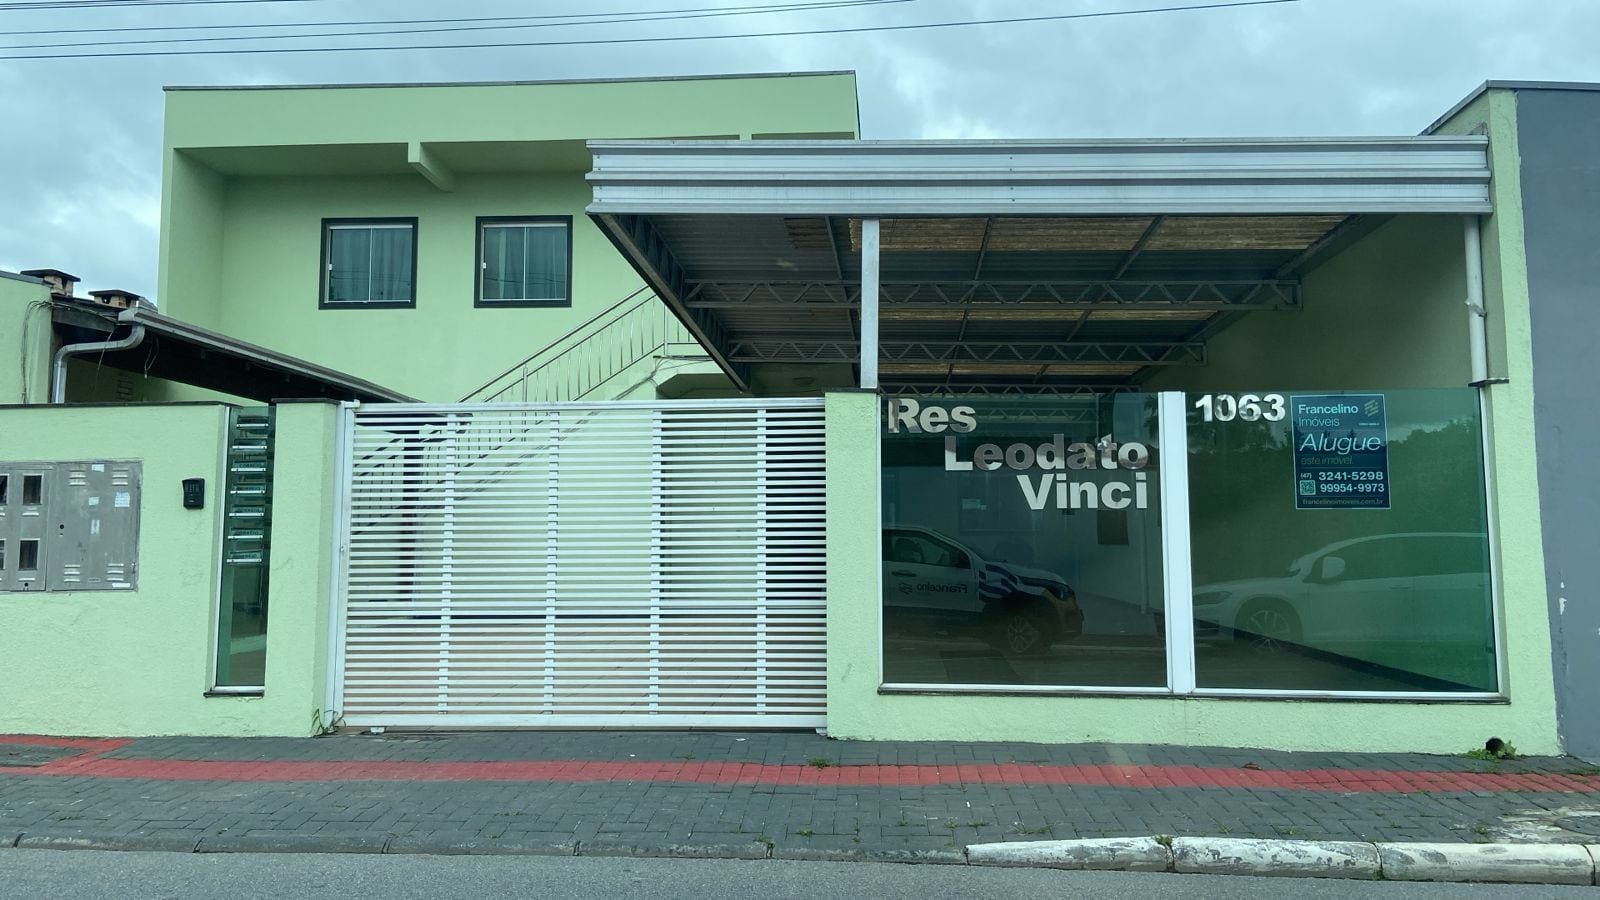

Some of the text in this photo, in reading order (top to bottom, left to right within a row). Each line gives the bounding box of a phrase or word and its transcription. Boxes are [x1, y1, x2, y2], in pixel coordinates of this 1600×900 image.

[887, 398, 977, 434] Res
[1195, 393, 1286, 422] 1063
[1298, 403, 1359, 414] Francelino
[1298, 417, 1340, 427] Imóveis
[944, 433, 1149, 471] Leodato
[1299, 432, 1381, 455] Alugue
[1301, 456, 1320, 465] este
[1318, 471, 1384, 481] 3241-5298
[1016, 471, 1147, 510] Vinci
[1320, 483, 1385, 493] 99954-9973
